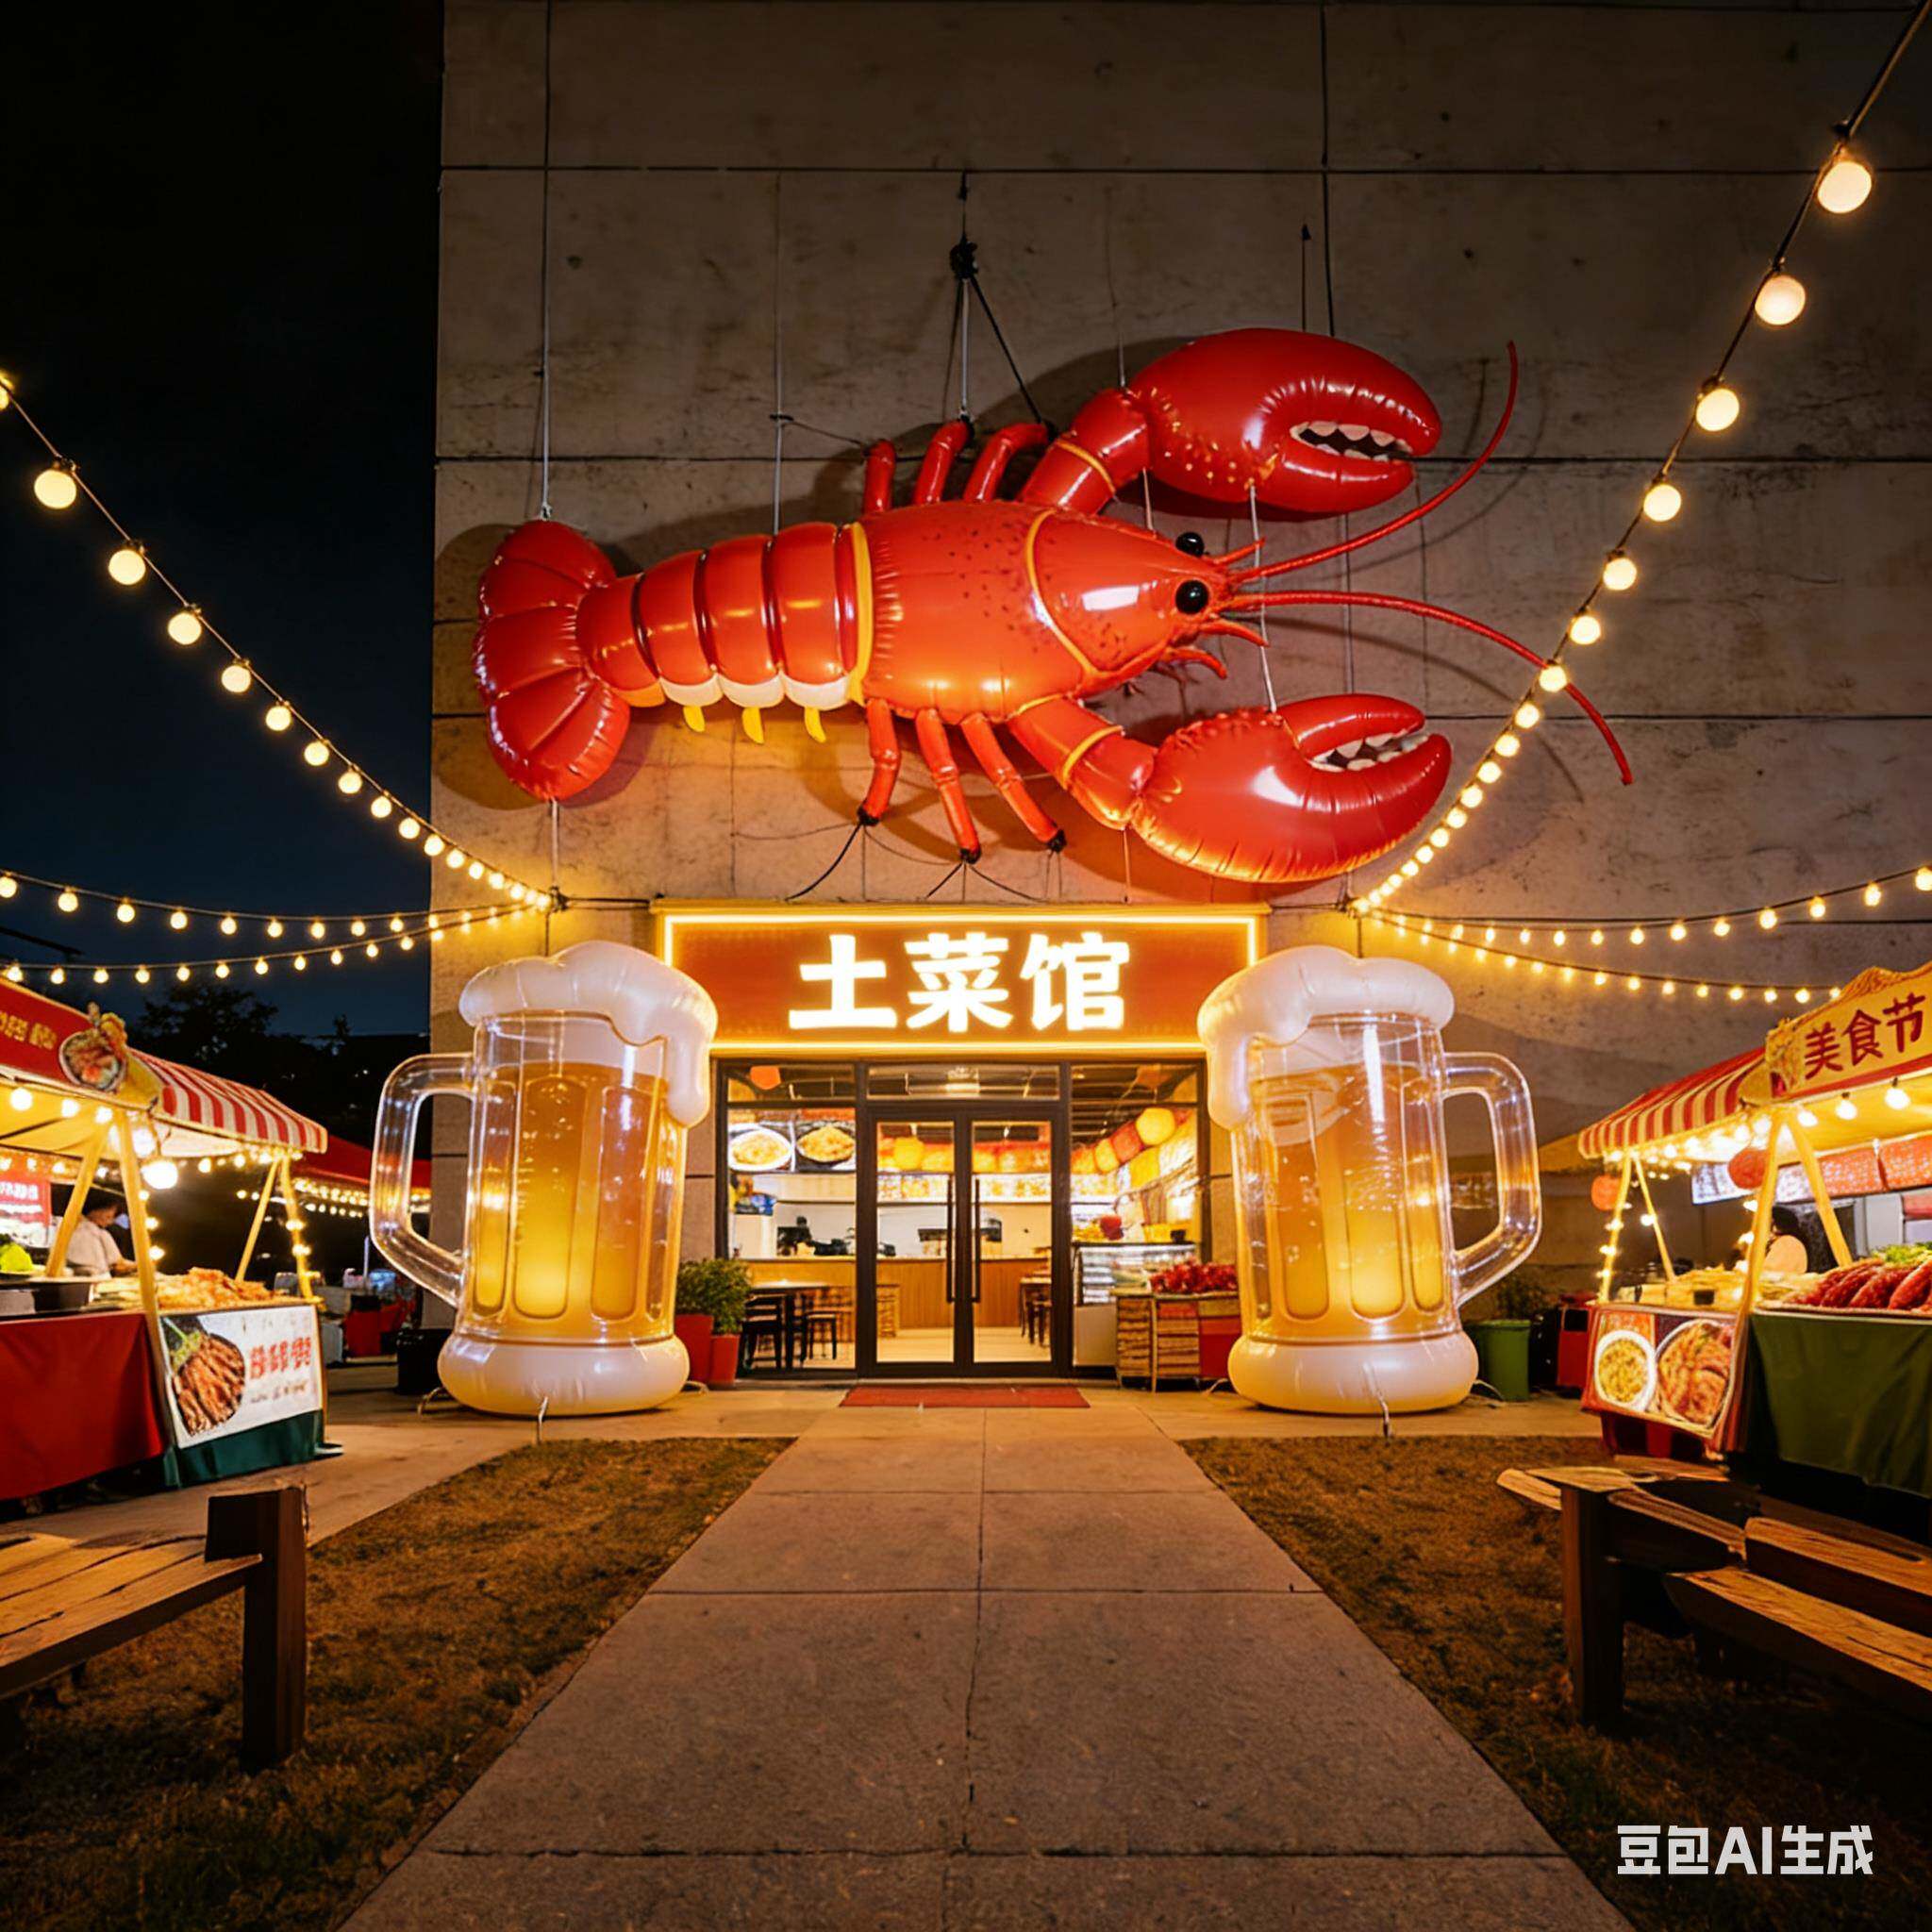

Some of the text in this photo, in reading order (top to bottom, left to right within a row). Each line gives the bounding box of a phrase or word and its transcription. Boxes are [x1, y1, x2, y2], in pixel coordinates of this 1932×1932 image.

[789, 931, 1131, 1033] 土菜馆
[1804, 991, 1926, 1080] 美食节
